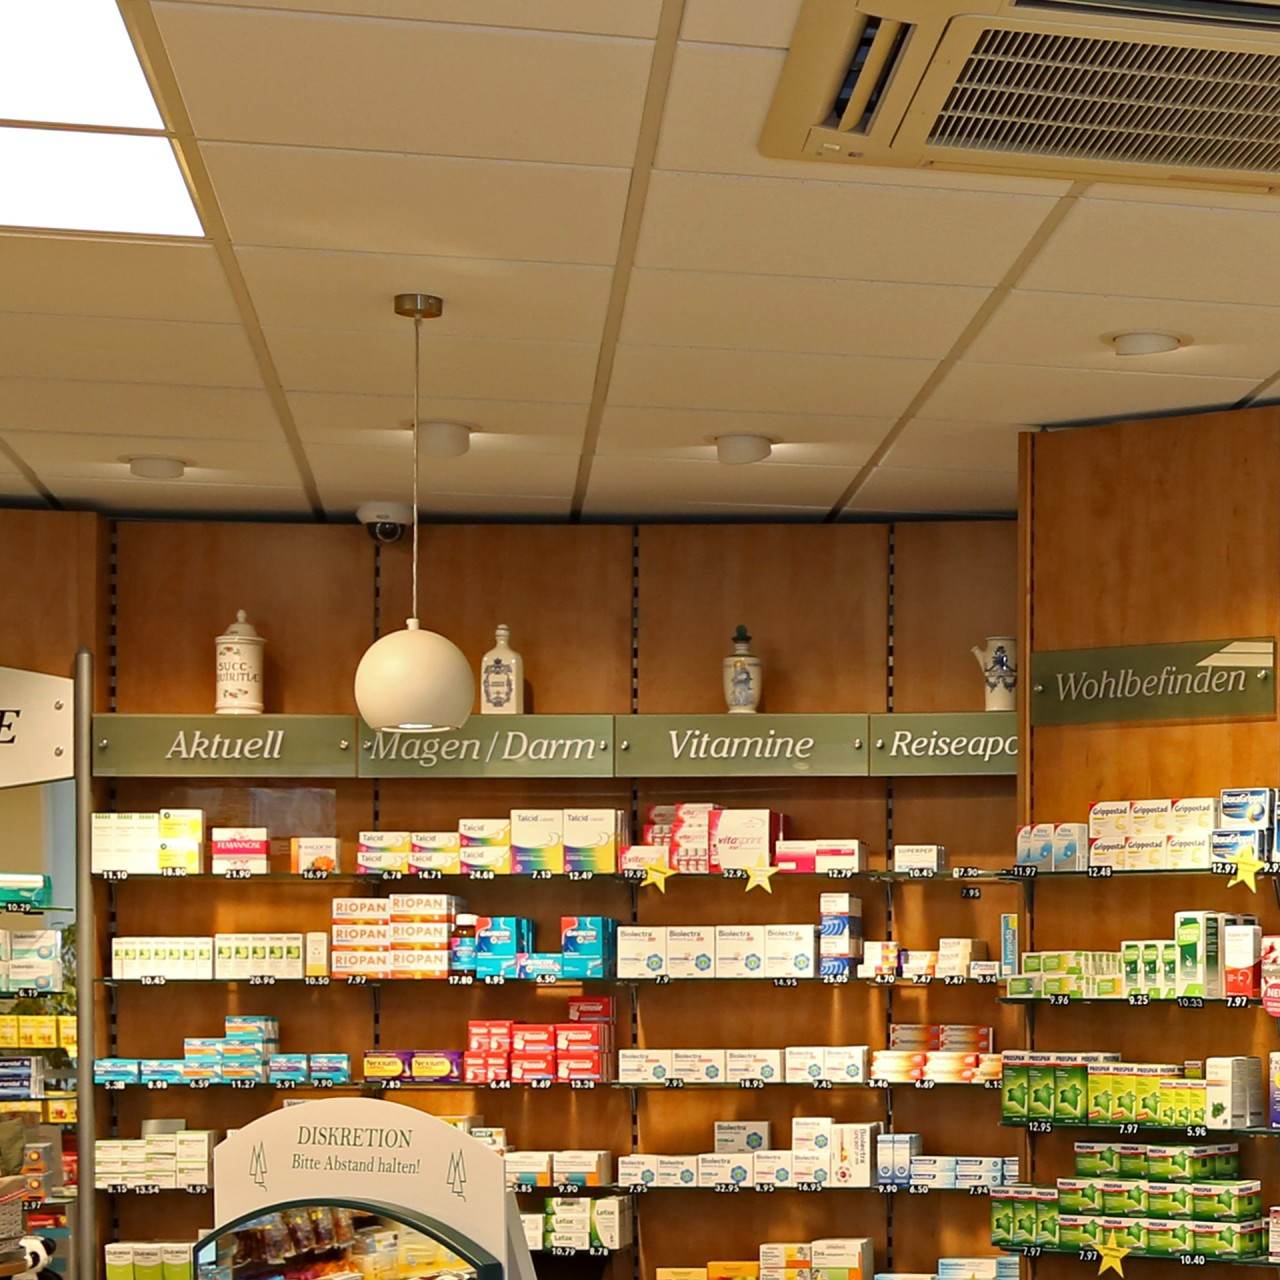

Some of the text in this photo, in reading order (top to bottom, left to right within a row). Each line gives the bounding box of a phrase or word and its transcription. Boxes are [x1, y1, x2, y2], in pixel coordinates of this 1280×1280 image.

[1056, 666, 1246, 700] Wohlbefinden
[166, 730, 285, 759] Aktuell
[669, 730, 814, 759] Vitamine
[1092, 807, 1128, 817] Grippostad
[1133, 805, 1168, 815] Grippostad
[336, 902, 386, 913] RIOPAN
[336, 929, 386, 940] RIOPAN
[298, 1126, 412, 1148] DISKRETION
[292, 1155, 420, 1174] Bitte Abstand halten!
[1181, 1255, 1205, 1265] 10.40
